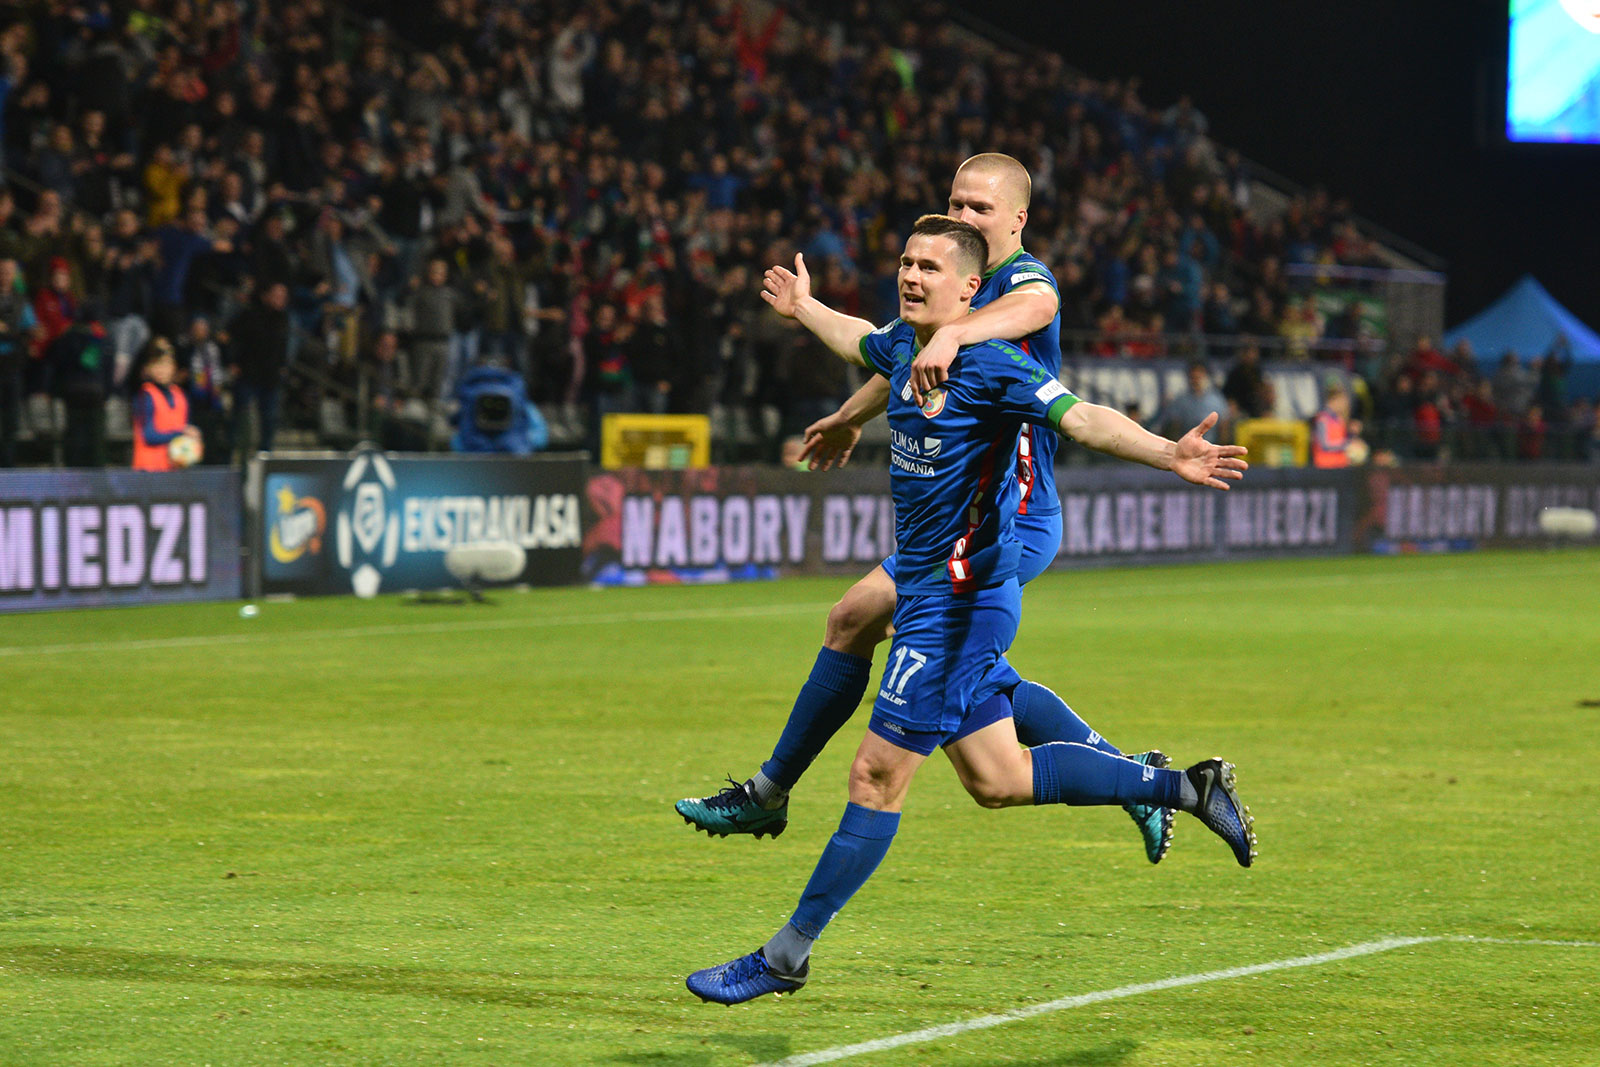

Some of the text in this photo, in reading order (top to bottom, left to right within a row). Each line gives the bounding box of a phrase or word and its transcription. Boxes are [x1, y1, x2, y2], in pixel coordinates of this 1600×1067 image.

[907, 437, 920, 455] SA
[0, 503, 206, 590] MIEDZI
[404, 494, 581, 552] EKSTRAKLASA
[622, 495, 810, 567] NABORY
[1058, 490, 1215, 556] KADEMII
[1226, 488, 1338, 546] MIEDZI
[887, 645, 927, 695] 17
